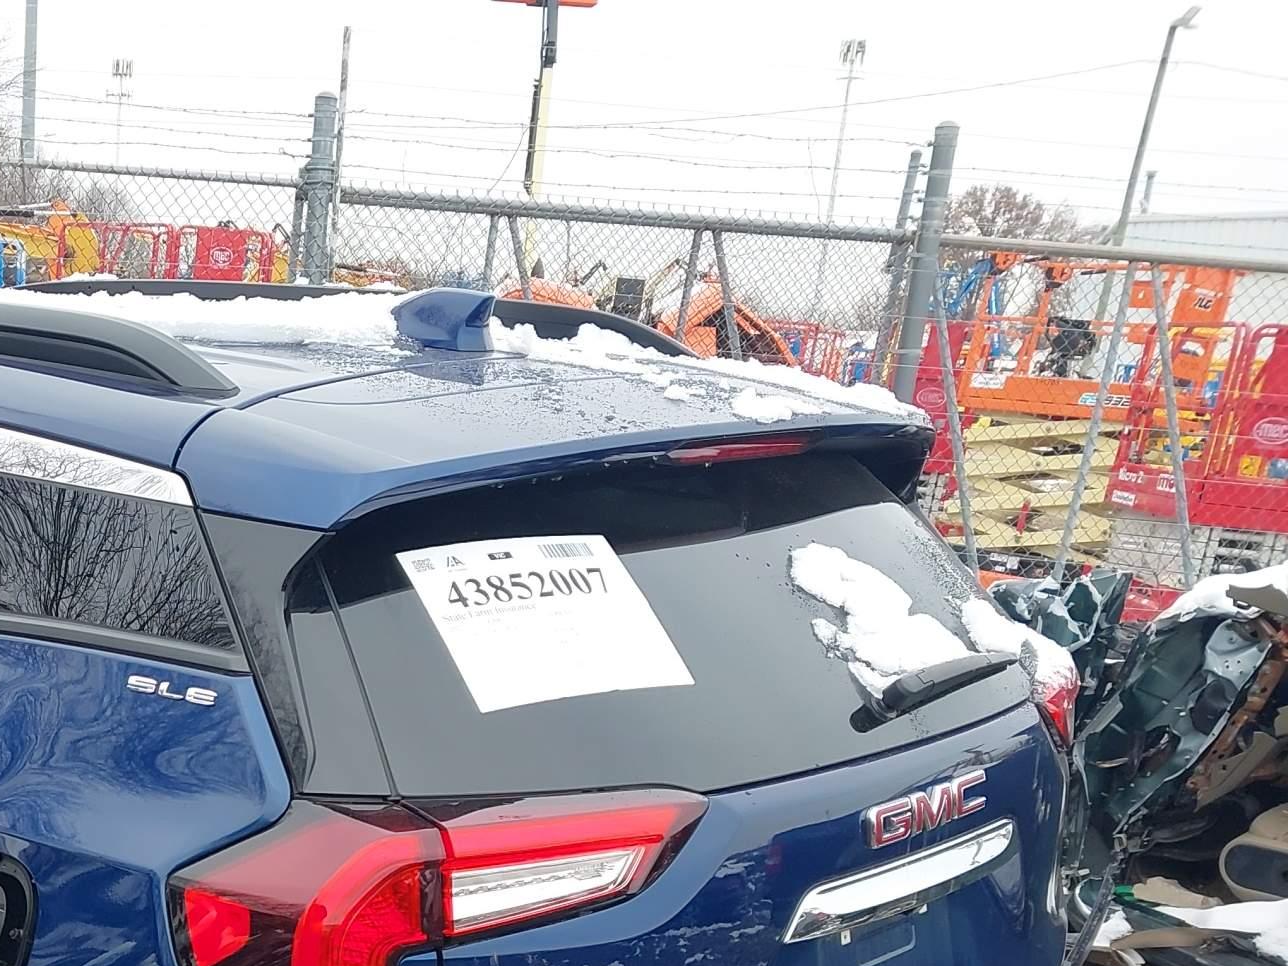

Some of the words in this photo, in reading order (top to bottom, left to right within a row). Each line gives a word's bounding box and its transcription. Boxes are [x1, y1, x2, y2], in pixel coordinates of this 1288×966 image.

[448, 567, 608, 608] 43852007
[126, 674, 218, 706] SLE
[864, 769, 987, 850] GMC
